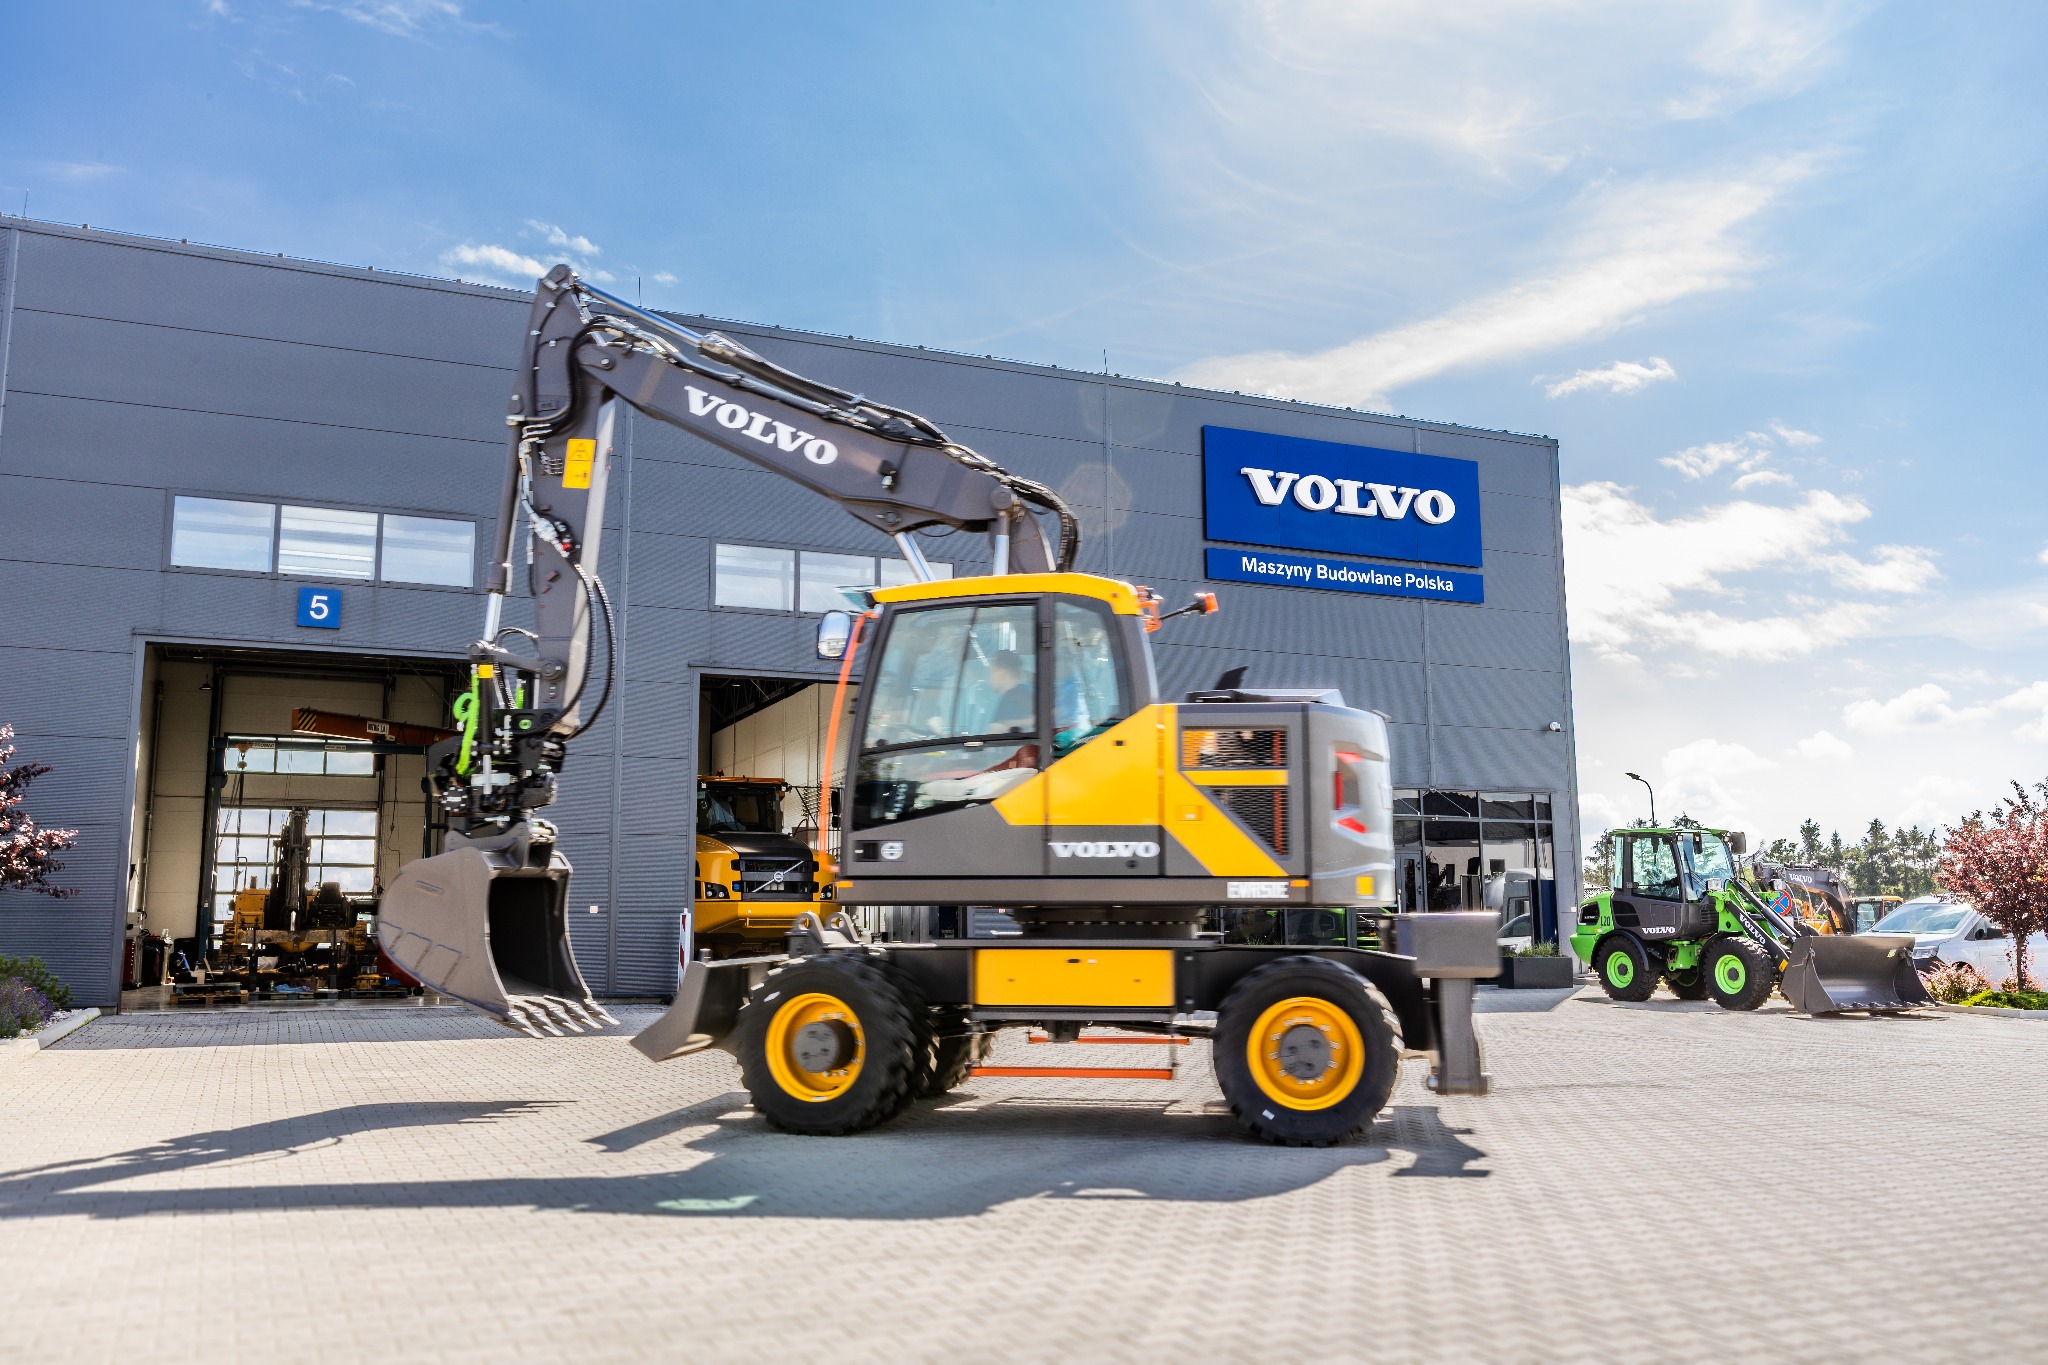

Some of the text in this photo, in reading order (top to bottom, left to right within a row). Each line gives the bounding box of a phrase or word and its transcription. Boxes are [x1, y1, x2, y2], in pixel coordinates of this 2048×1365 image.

[684, 385, 838, 465] VOLVO
[1241, 467, 1456, 525] VOLVO
[1241, 556, 1454, 592] Maszyny Budowlane Polska
[309, 594, 329, 620] 5
[1047, 841, 1160, 858] VOLVO
[1788, 873, 1813, 884] VOLVO
[1600, 915, 1611, 927] L20
[1641, 926, 1676, 935] VOLVO
[1738, 913, 1766, 945] VOLVO
